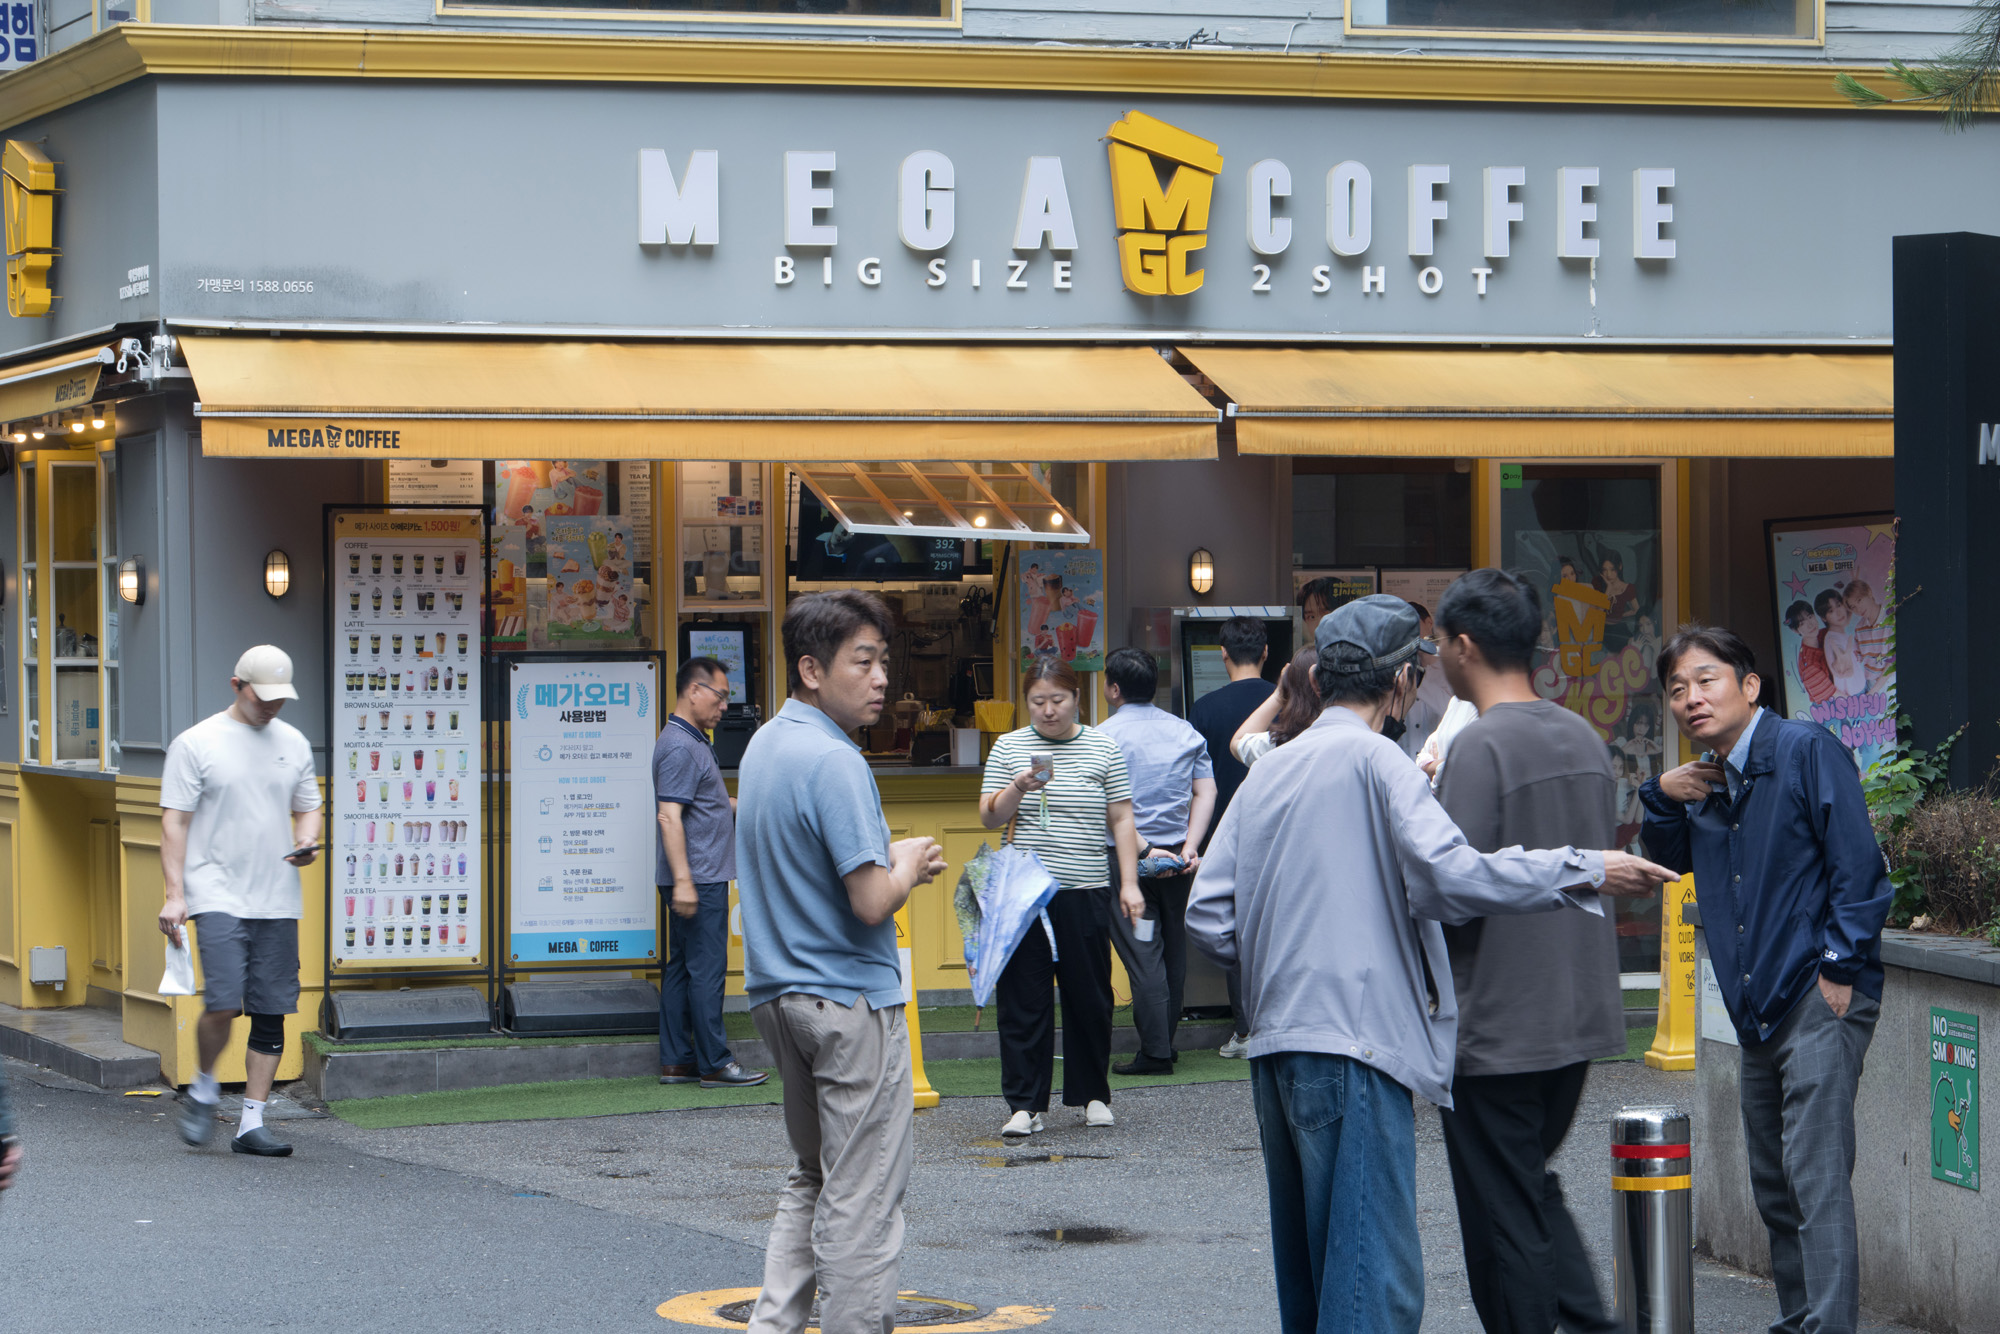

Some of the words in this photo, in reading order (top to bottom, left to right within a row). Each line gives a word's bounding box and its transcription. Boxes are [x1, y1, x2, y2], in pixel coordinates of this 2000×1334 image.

[638, 148, 1078, 251] MEGA
[1246, 158, 1677, 259] COFFEE
[774, 255, 882, 285] BIG
[926, 257, 1073, 289] SIZE
[1251, 263, 1272, 292] 2
[1311, 264, 1493, 295] SHOT
[197, 278, 244, 293] 가맹문의
[249, 280, 314, 293] 1588.0656
[268, 429, 325, 448] MEGA
[345, 429, 401, 449] COFFEE
[630, 470, 641, 479] TEA
[355, 522, 368, 531] 메가
[370, 522, 390, 531] 사이즈
[390, 522, 422, 531] 아메리카노
[424, 520, 460, 532] 1,500원!
[935, 539, 955, 549] 392
[934, 560, 953, 570] 291
[1808, 563, 1828, 572] MEGA
[1834, 561, 1854, 570] COFFEE
[535, 682, 630, 708] 메가오더
[560, 710, 607, 722] 사용방법
[548, 941, 578, 954] MEGA
[590, 940, 619, 952] COFFEE
[1932, 1014, 1948, 1038] NO
[1932, 1040, 1976, 1070] SMOKING
